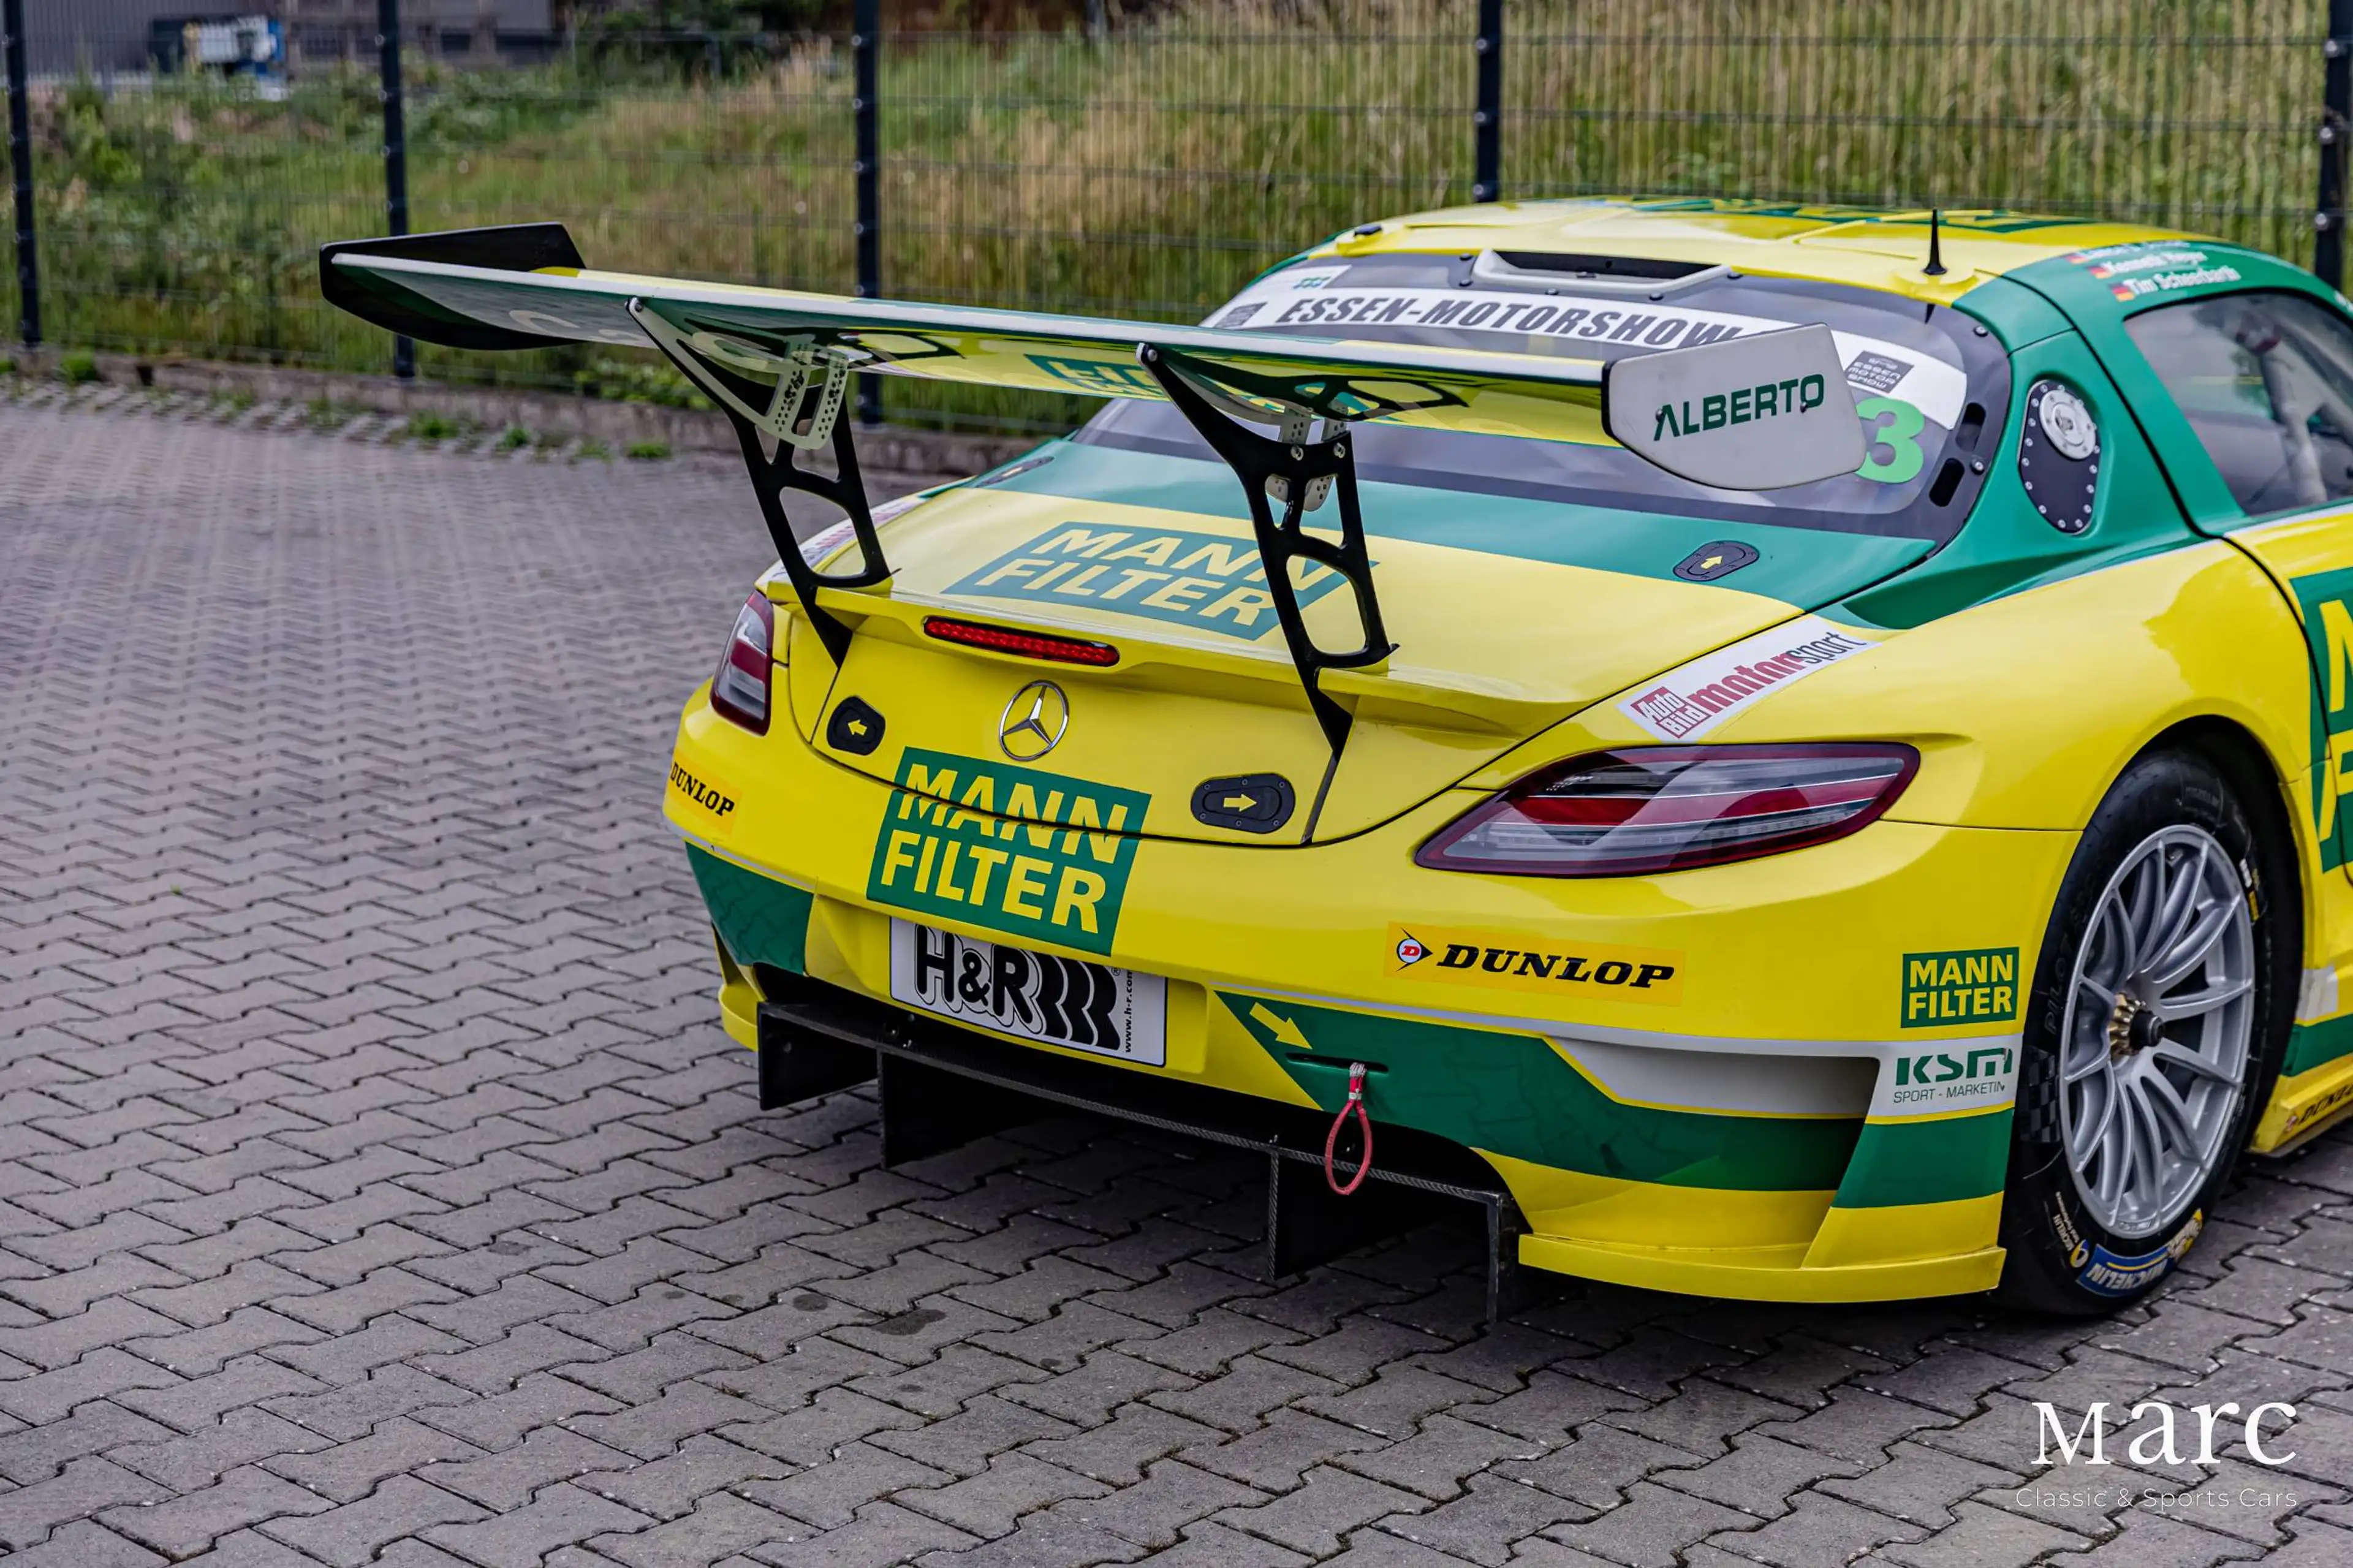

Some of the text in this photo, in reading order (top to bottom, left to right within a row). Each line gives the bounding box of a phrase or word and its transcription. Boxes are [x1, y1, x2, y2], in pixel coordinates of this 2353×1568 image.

[1654, 373, 1825, 441] ALBERTO
[974, 558, 1276, 626] FILTER
[670, 761, 735, 816] DUNLOP
[897, 763, 1129, 864] MANN
[881, 829, 1106, 934] FILTER
[1437, 944, 1675, 988] DUNLOP
[1909, 954, 2013, 988] MANN
[1909, 986, 2012, 1020] FILTER
[1893, 1088, 1936, 1104] SPORT
